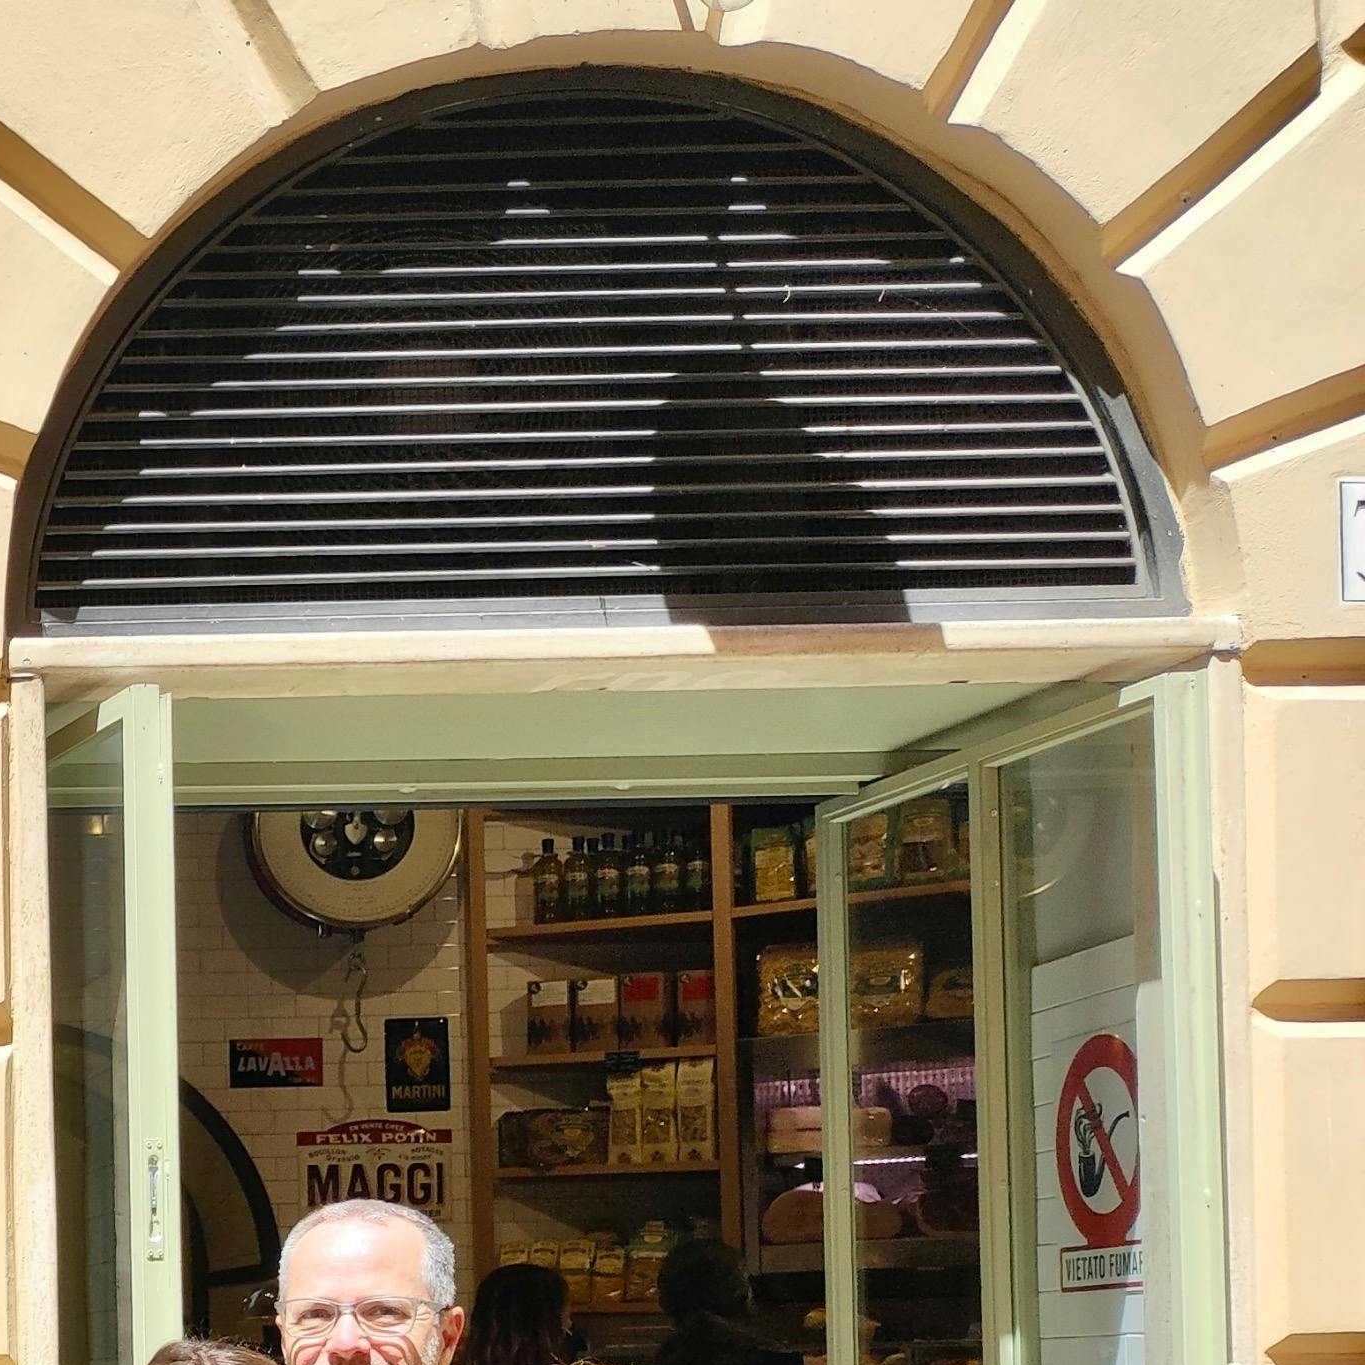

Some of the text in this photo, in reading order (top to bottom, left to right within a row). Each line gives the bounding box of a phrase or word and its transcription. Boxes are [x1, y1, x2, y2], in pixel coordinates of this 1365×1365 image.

[391, 1084, 447, 1100] MARTINI
[315, 1132, 438, 1145] FELIX POTIN
[306, 1162, 444, 1207] MAGGI
[1065, 1254, 1105, 1282] VIETATO
